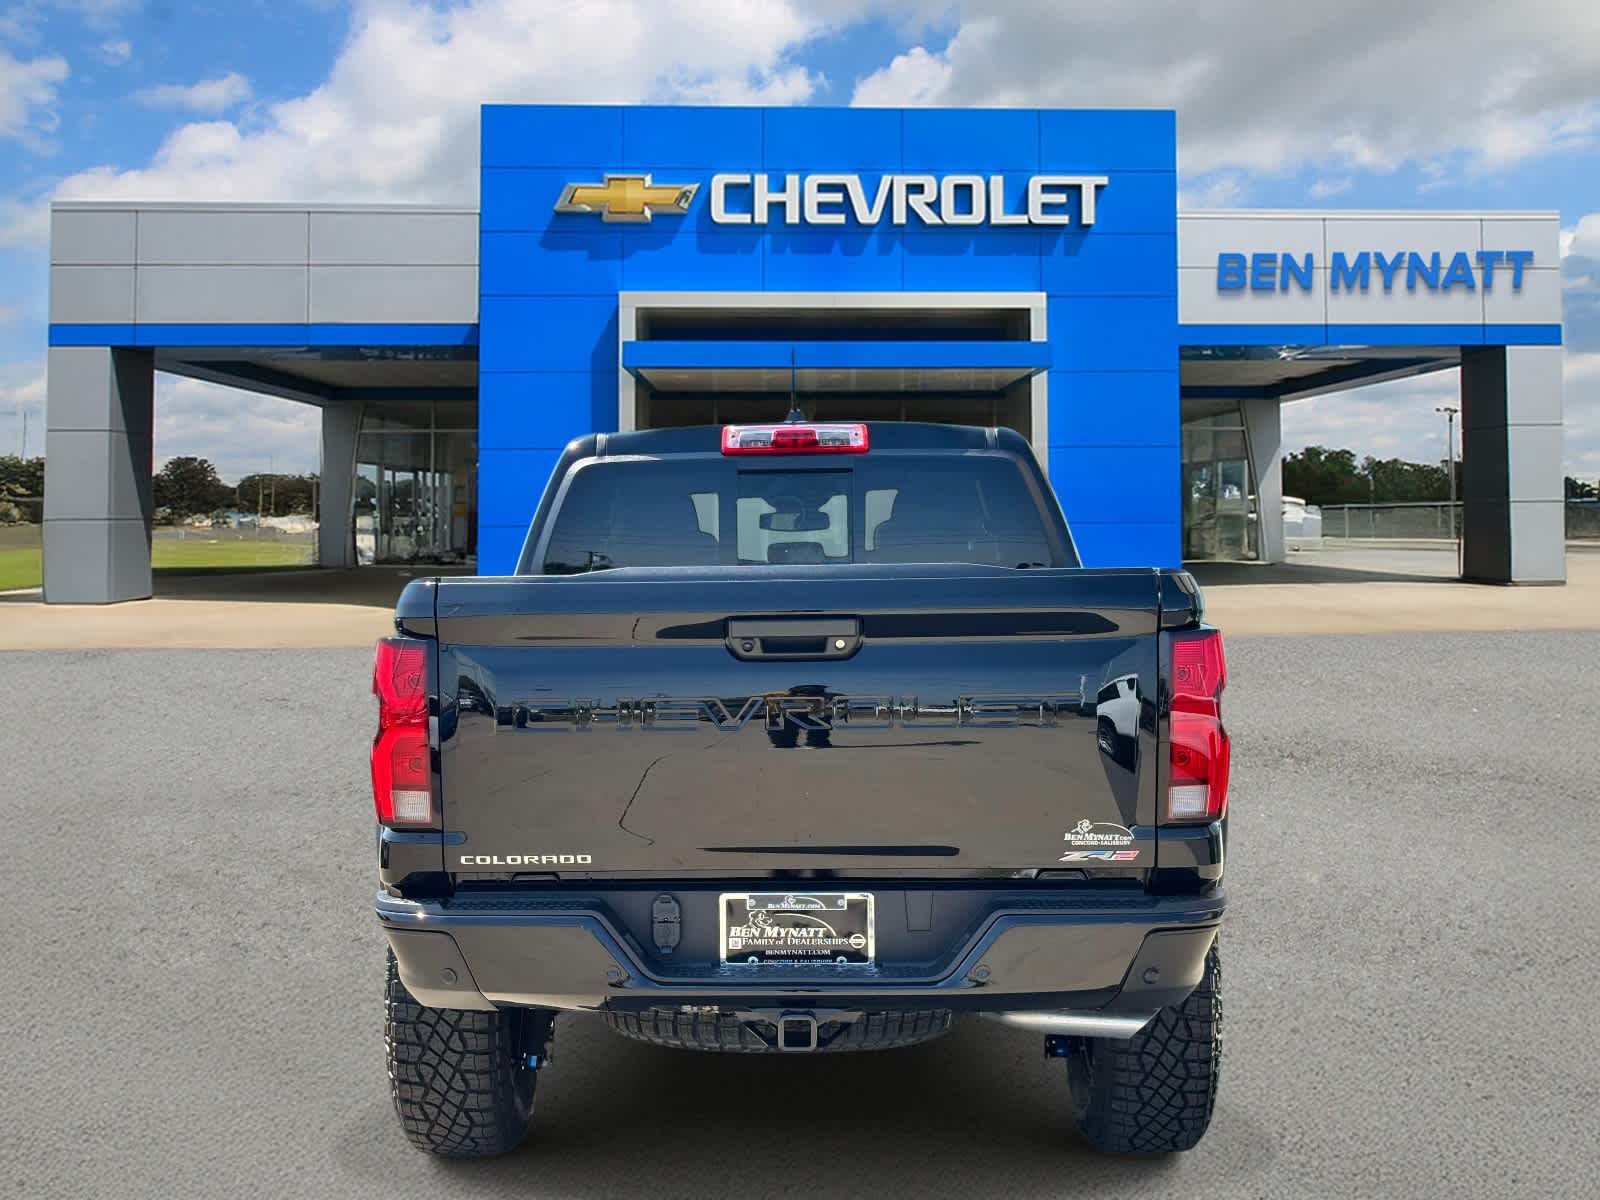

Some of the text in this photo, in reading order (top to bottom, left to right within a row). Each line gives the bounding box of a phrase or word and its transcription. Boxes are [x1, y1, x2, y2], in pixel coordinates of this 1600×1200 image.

[711, 173, 1109, 225] CHEVROLET
[1217, 250, 1534, 290] BEN MYNATT
[460, 854, 592, 865] COLORADO
[1058, 850, 1140, 862] ZR2
[729, 926, 828, 938] BEN MYNATT
[742, 937, 775, 946] FAMILY
[787, 937, 849, 946] DEALERSHIPS
